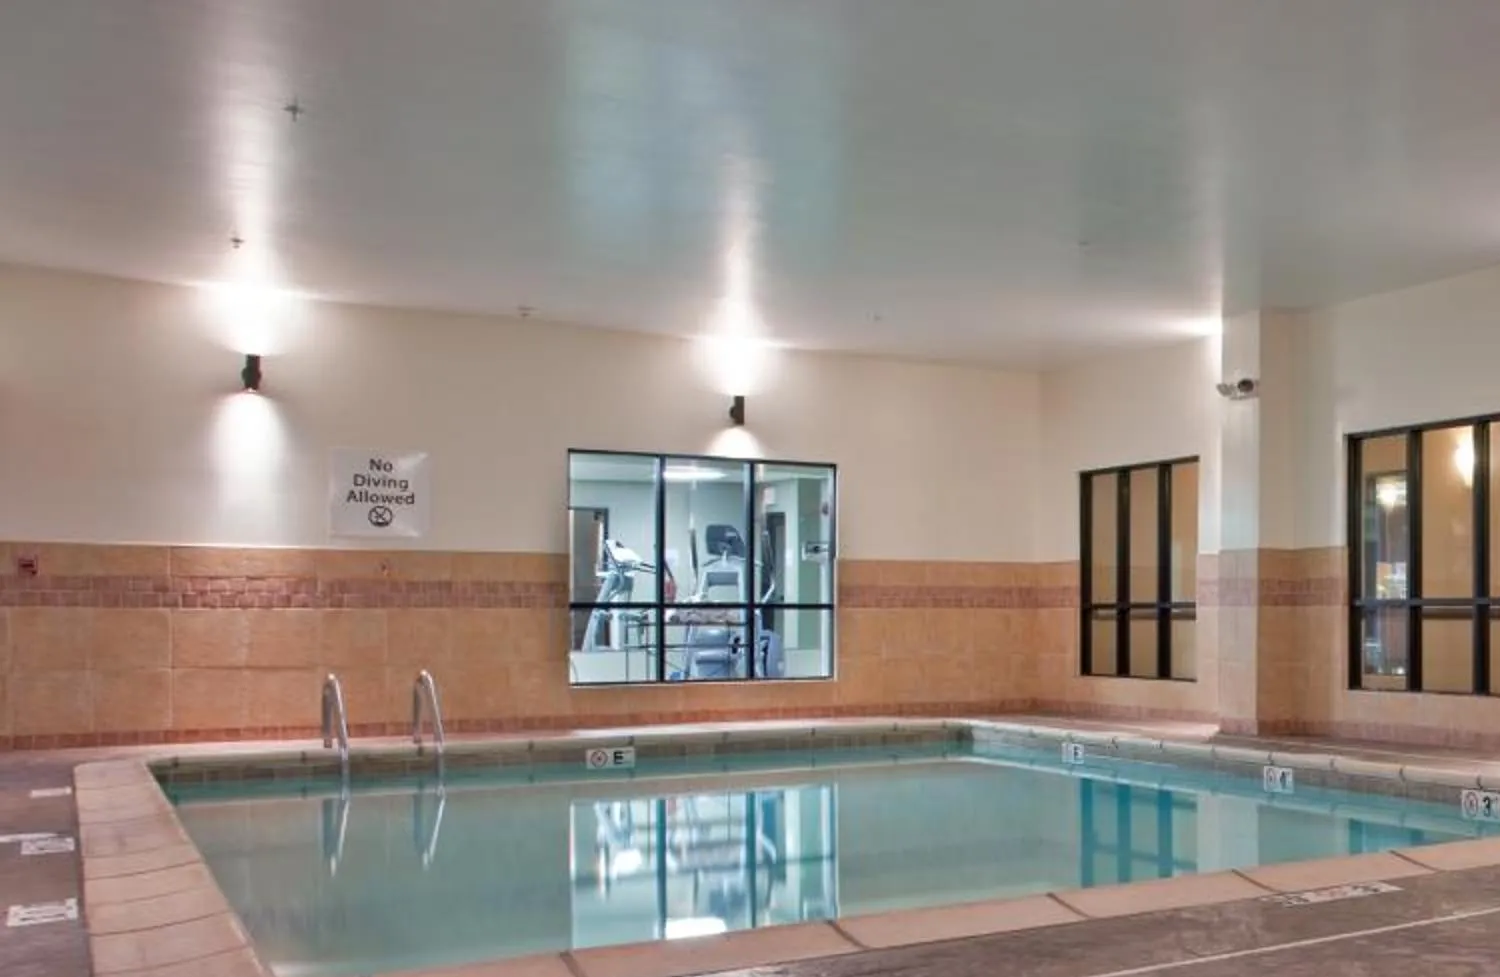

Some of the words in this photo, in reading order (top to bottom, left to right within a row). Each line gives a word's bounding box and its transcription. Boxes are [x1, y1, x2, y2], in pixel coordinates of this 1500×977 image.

[369, 458, 393, 473] No
[353, 473, 409, 492] Diving
[346, 489, 415, 505] Allowed
